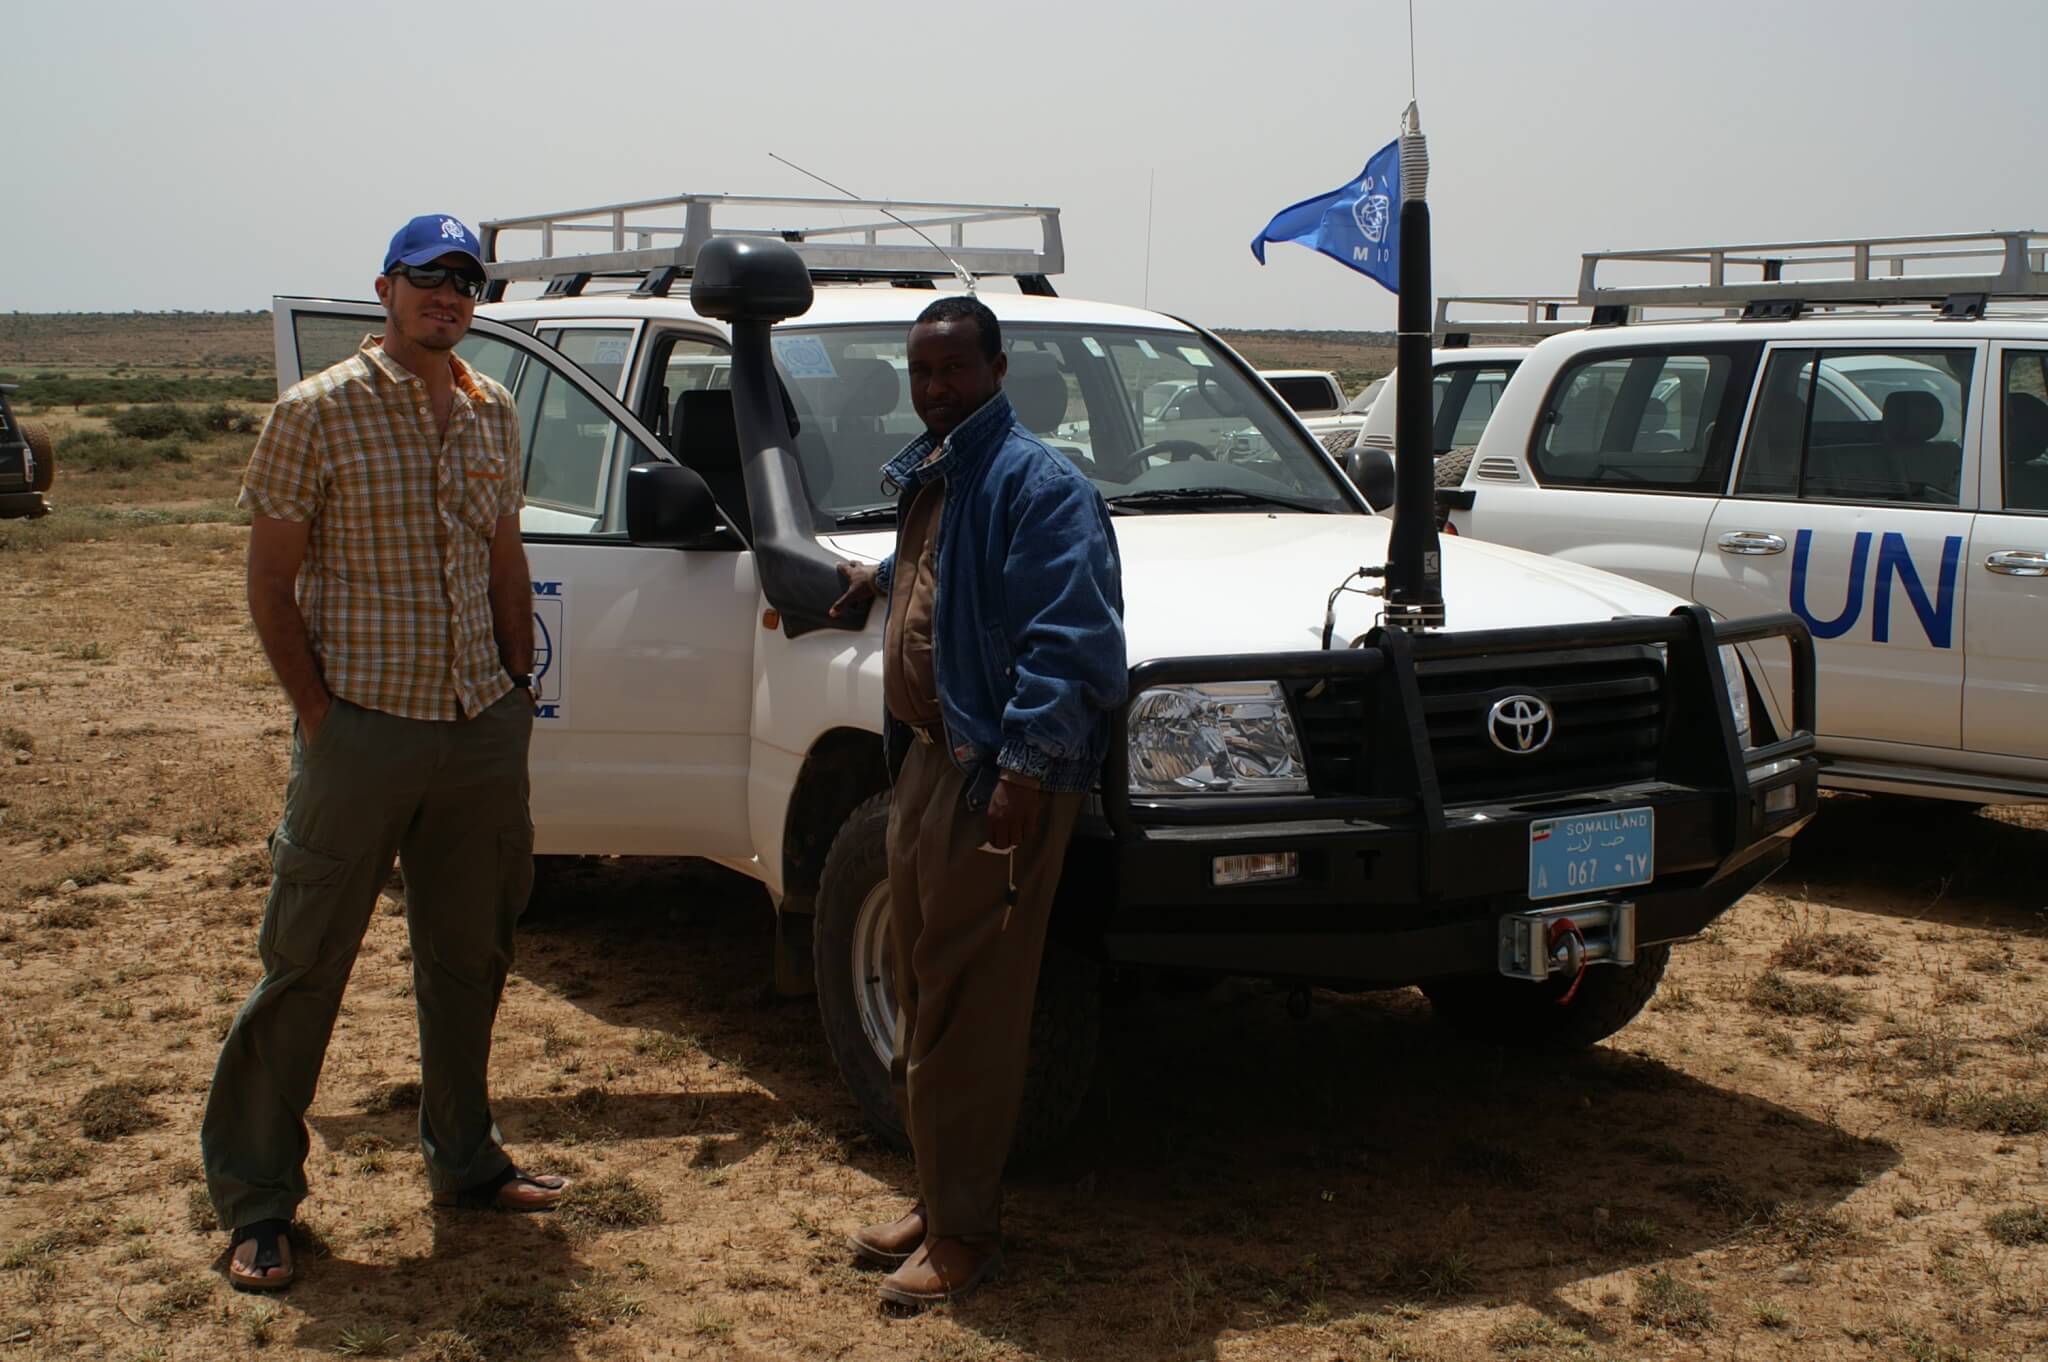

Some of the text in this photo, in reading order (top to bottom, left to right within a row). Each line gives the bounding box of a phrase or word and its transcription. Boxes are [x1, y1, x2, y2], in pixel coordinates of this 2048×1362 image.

[1789, 528, 1963, 649] UN
[1567, 815, 1648, 836] SOMALILAND
[1536, 858, 1598, 890] A 067
